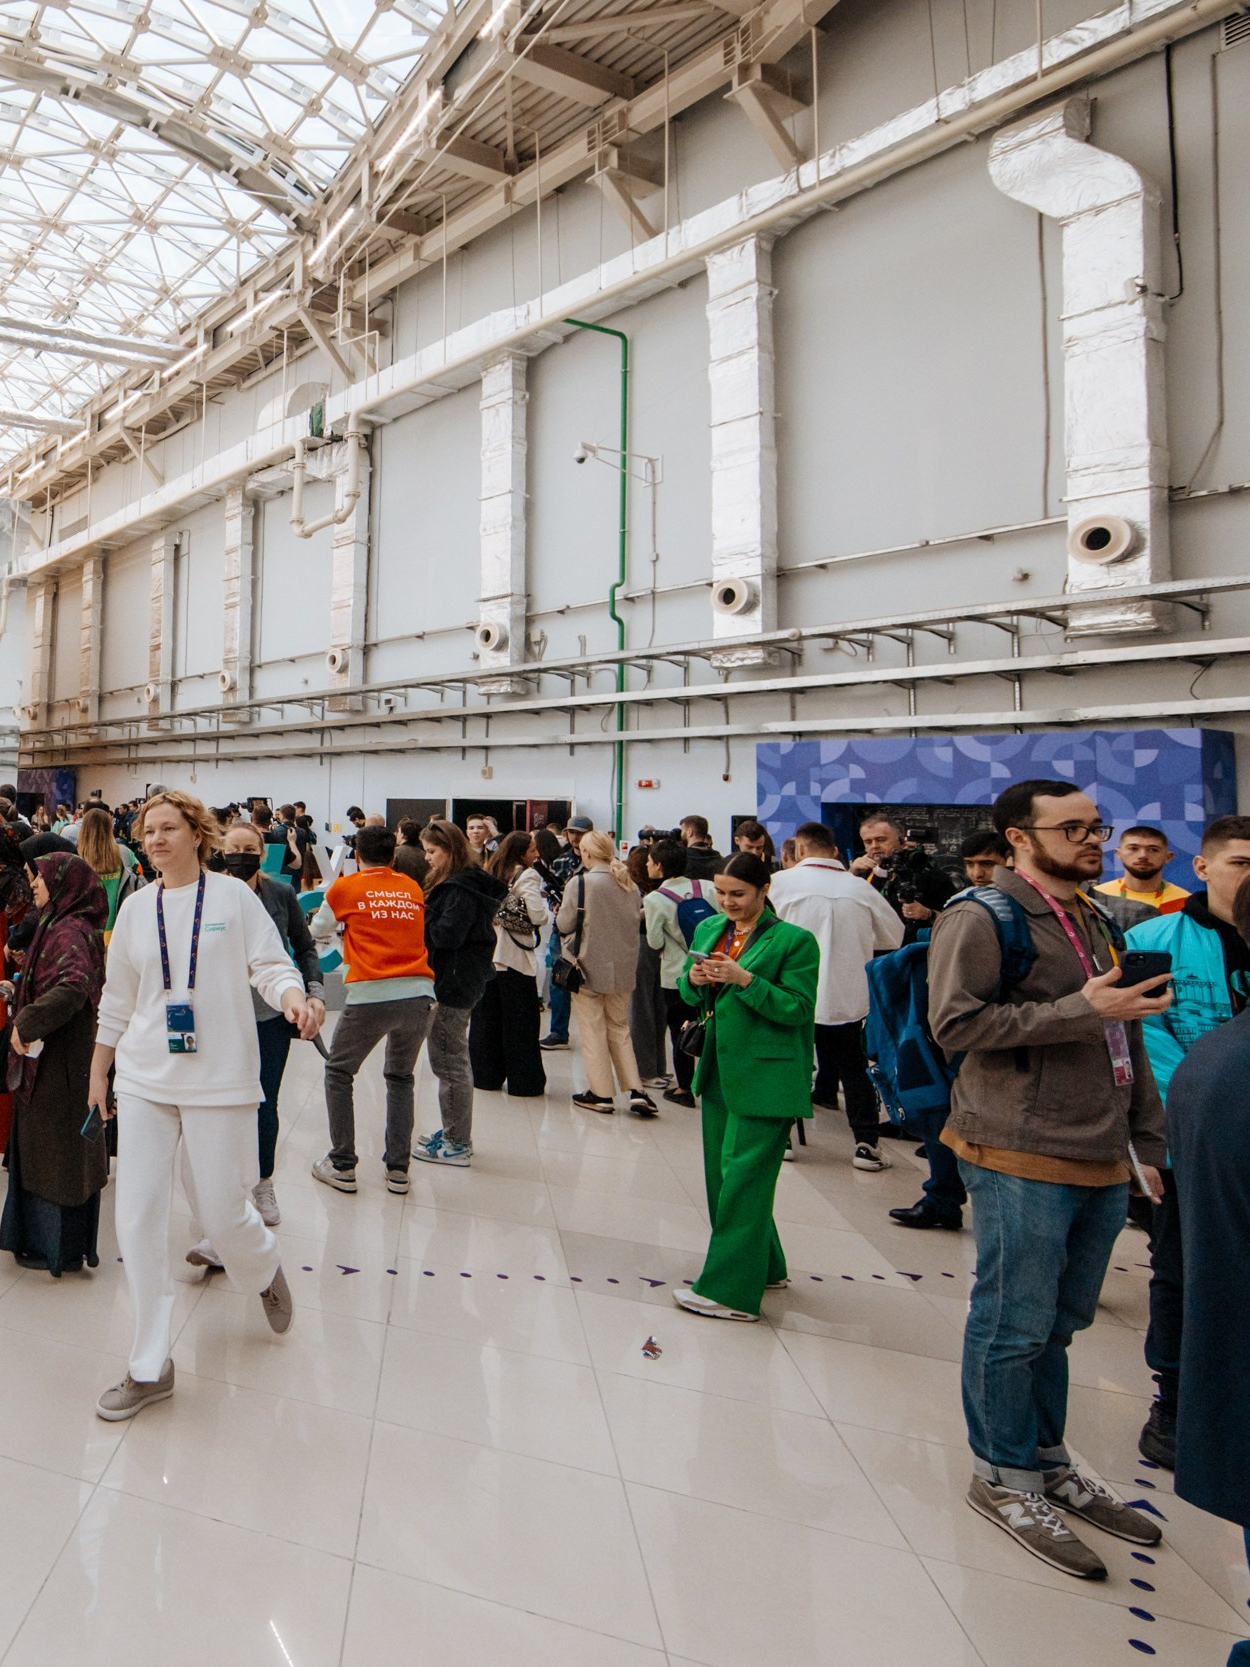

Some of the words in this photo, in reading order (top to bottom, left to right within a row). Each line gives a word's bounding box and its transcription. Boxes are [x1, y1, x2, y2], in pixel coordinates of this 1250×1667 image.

[365, 890, 412, 900] СМЫСЛ
[357, 901, 366, 911] В
[369, 900, 421, 912] КАЖДОМ
[371, 910, 388, 920] ИЗ
[391, 910, 415, 921] НАС
